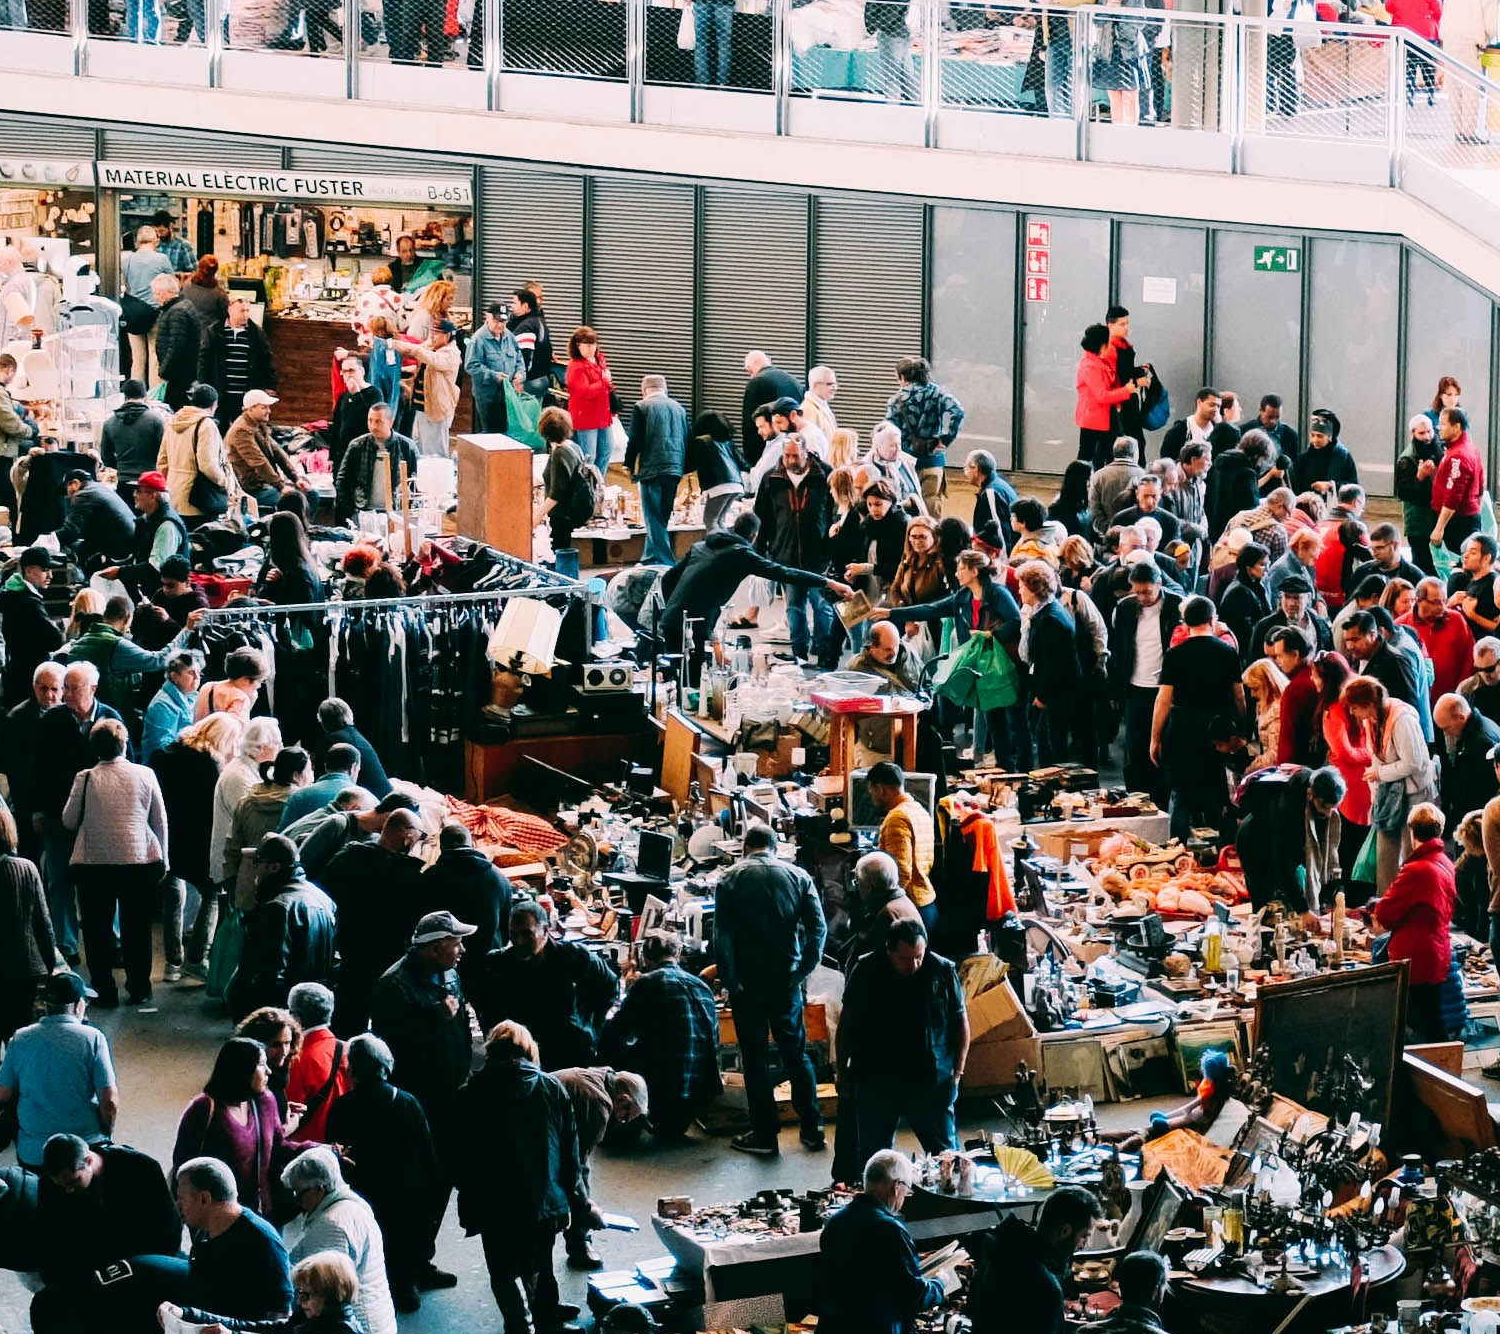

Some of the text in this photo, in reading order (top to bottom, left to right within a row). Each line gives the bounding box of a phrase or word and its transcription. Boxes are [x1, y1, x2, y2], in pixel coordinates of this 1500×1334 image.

[105, 169, 197, 188] MATERIAL
[202, 171, 288, 193] ELÈCTRIC
[295, 179, 364, 196] FUSTER
[427, 185, 470, 202] B-651
